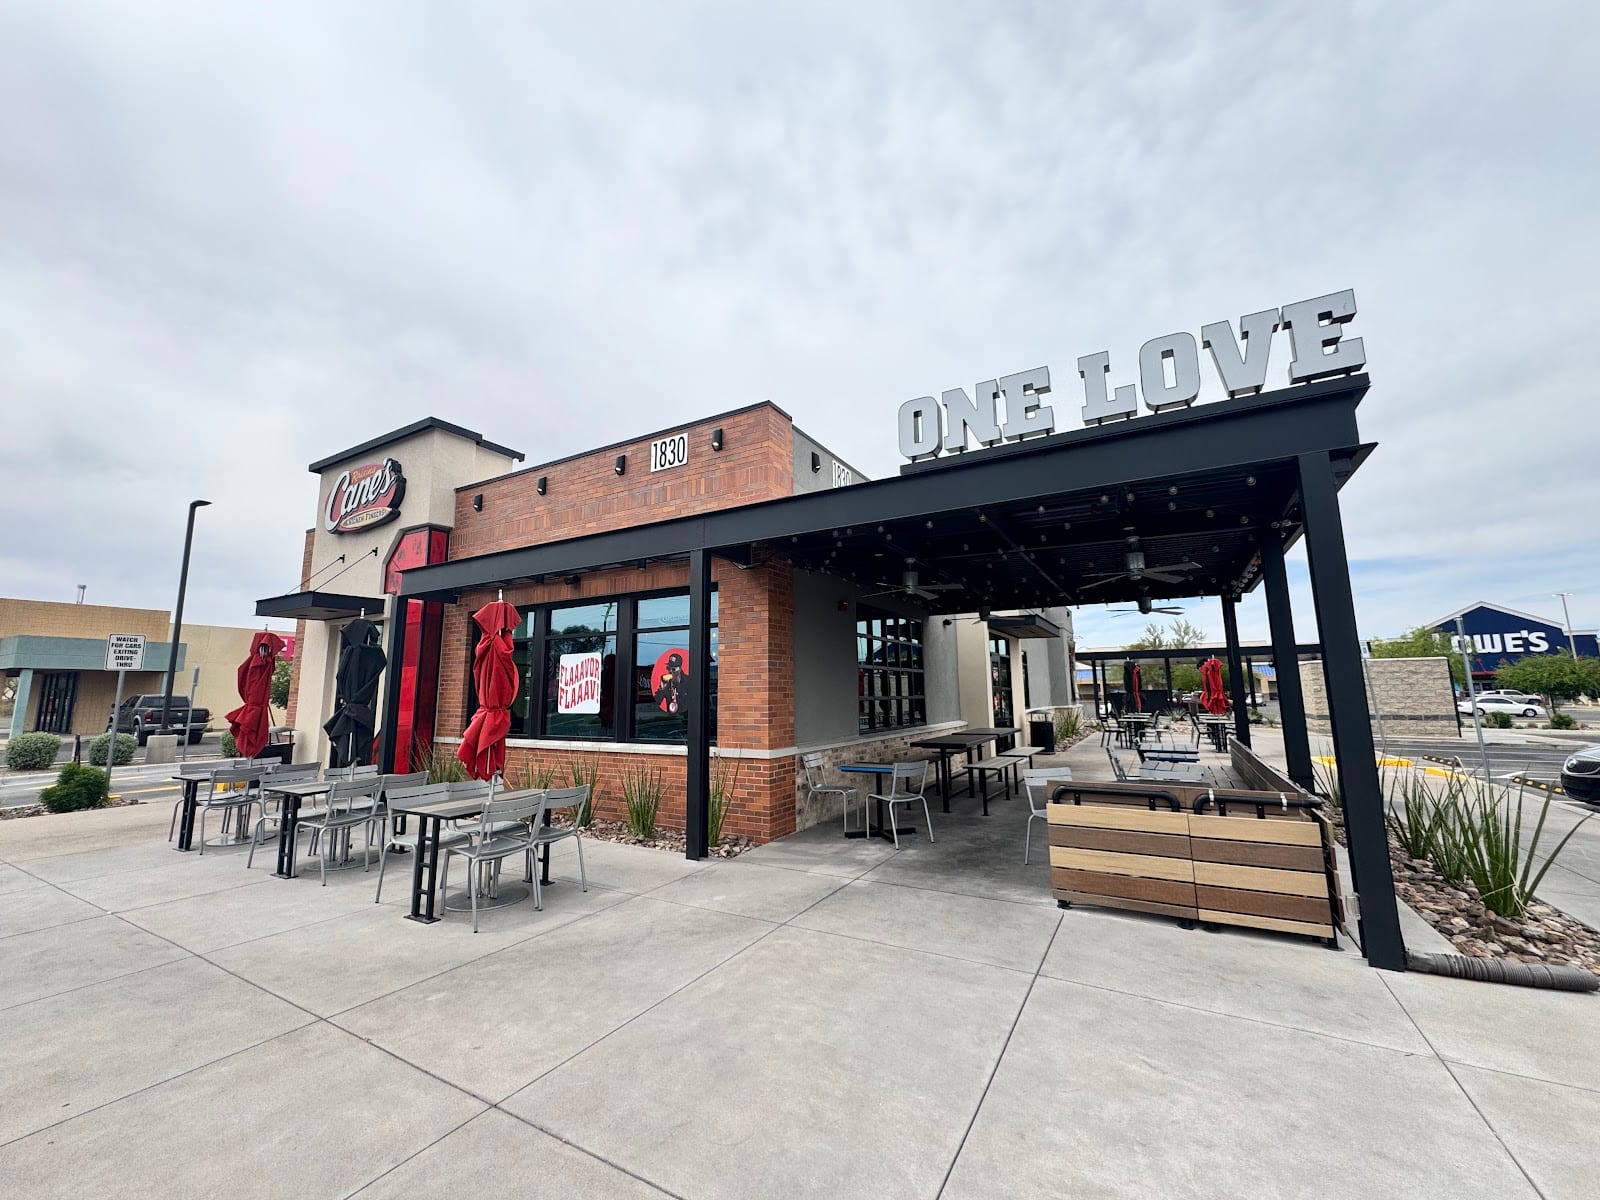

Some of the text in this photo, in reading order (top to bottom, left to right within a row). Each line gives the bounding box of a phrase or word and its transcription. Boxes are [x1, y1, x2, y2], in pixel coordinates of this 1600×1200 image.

[898, 288, 1367, 461] ONE LOVE
[653, 436, 686, 470] 1830
[325, 458, 397, 531] Cane's
[561, 657, 599, 687] FLAAAVOR
[559, 680, 599, 709] FLAAAV!
